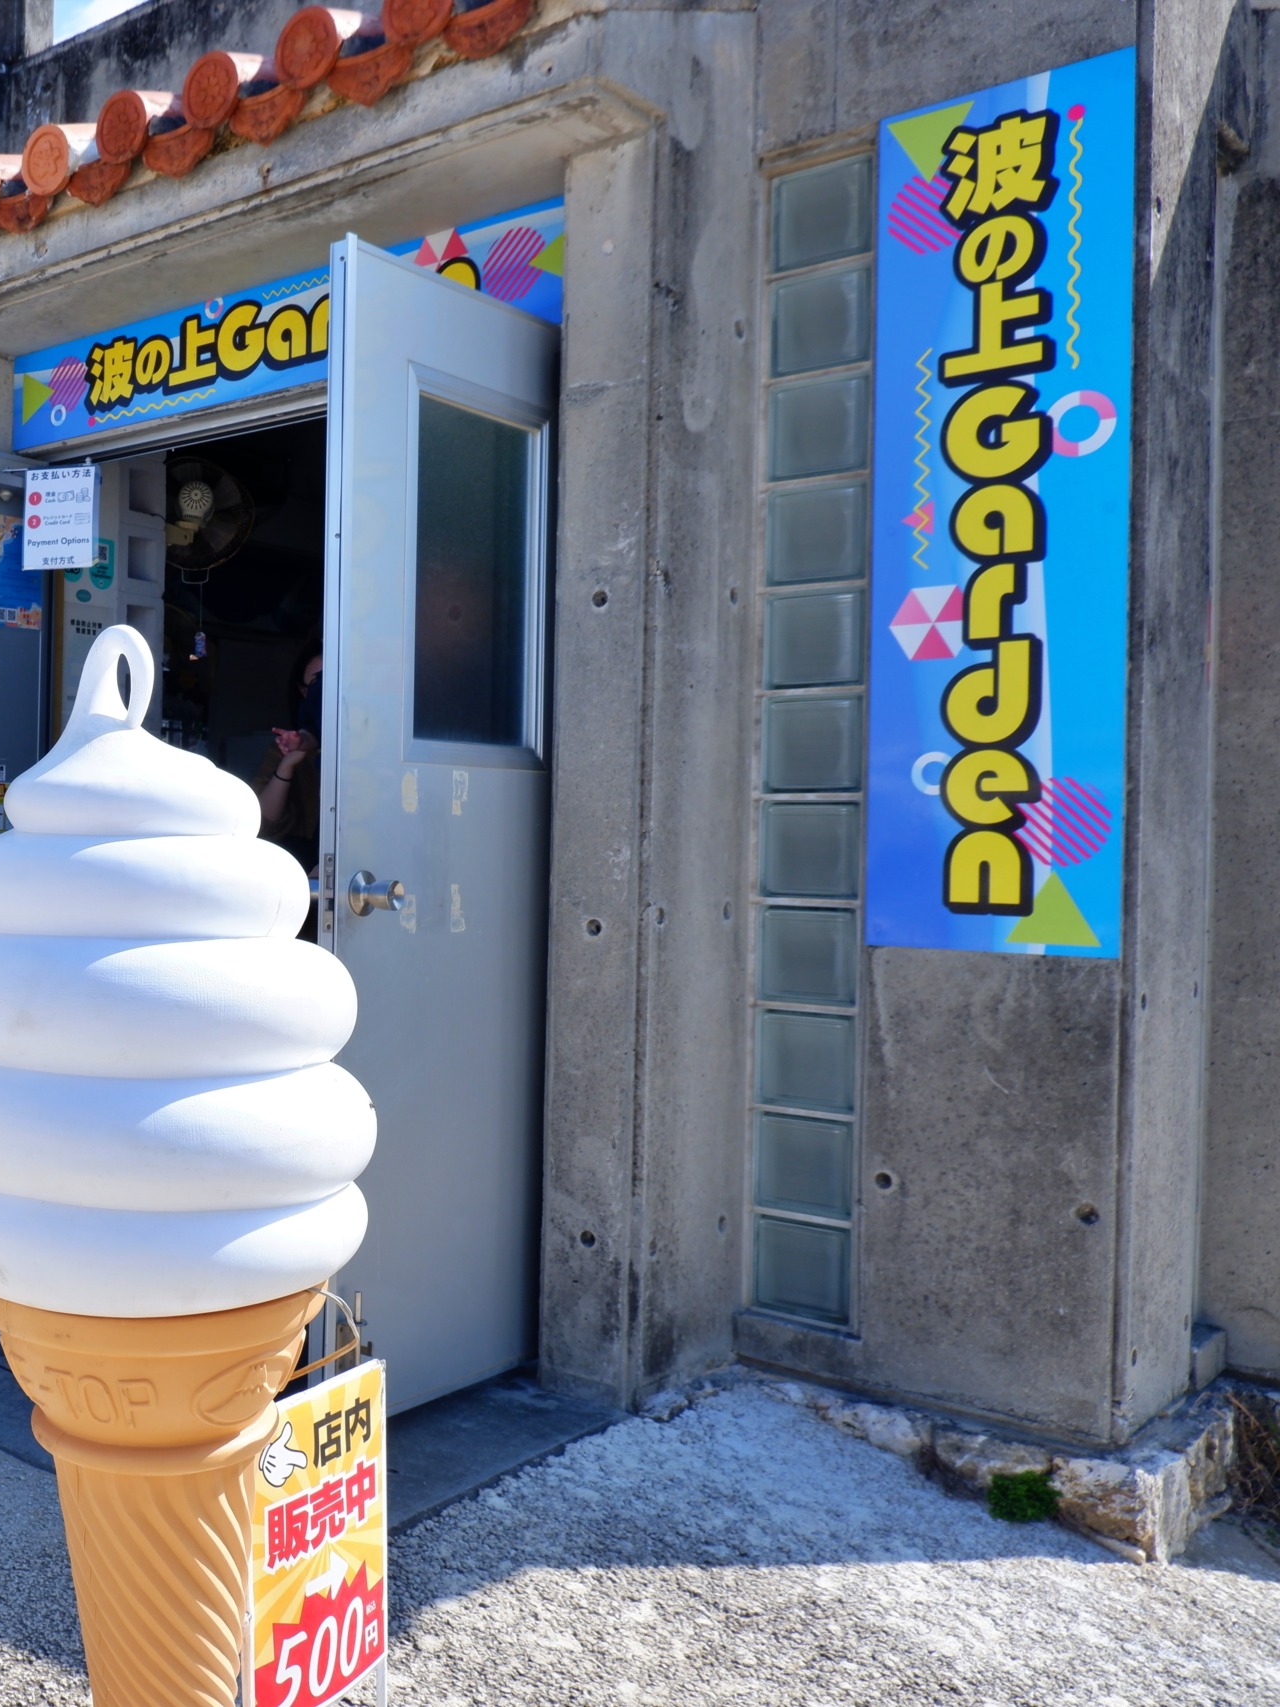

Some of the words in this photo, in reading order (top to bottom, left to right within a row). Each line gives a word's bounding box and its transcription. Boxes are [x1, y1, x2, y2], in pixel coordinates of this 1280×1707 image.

[31, 469, 91, 481] お支払い方法
[941, 112, 1053, 911] 波の上Garden
[27, 538, 59, 548] Payment
[61, 536, 90, 547] Options
[42, 556, 75, 566] 支付方式
[312, 1397, 372, 1469] 店内
[266, 1460, 377, 1570] 販売中
